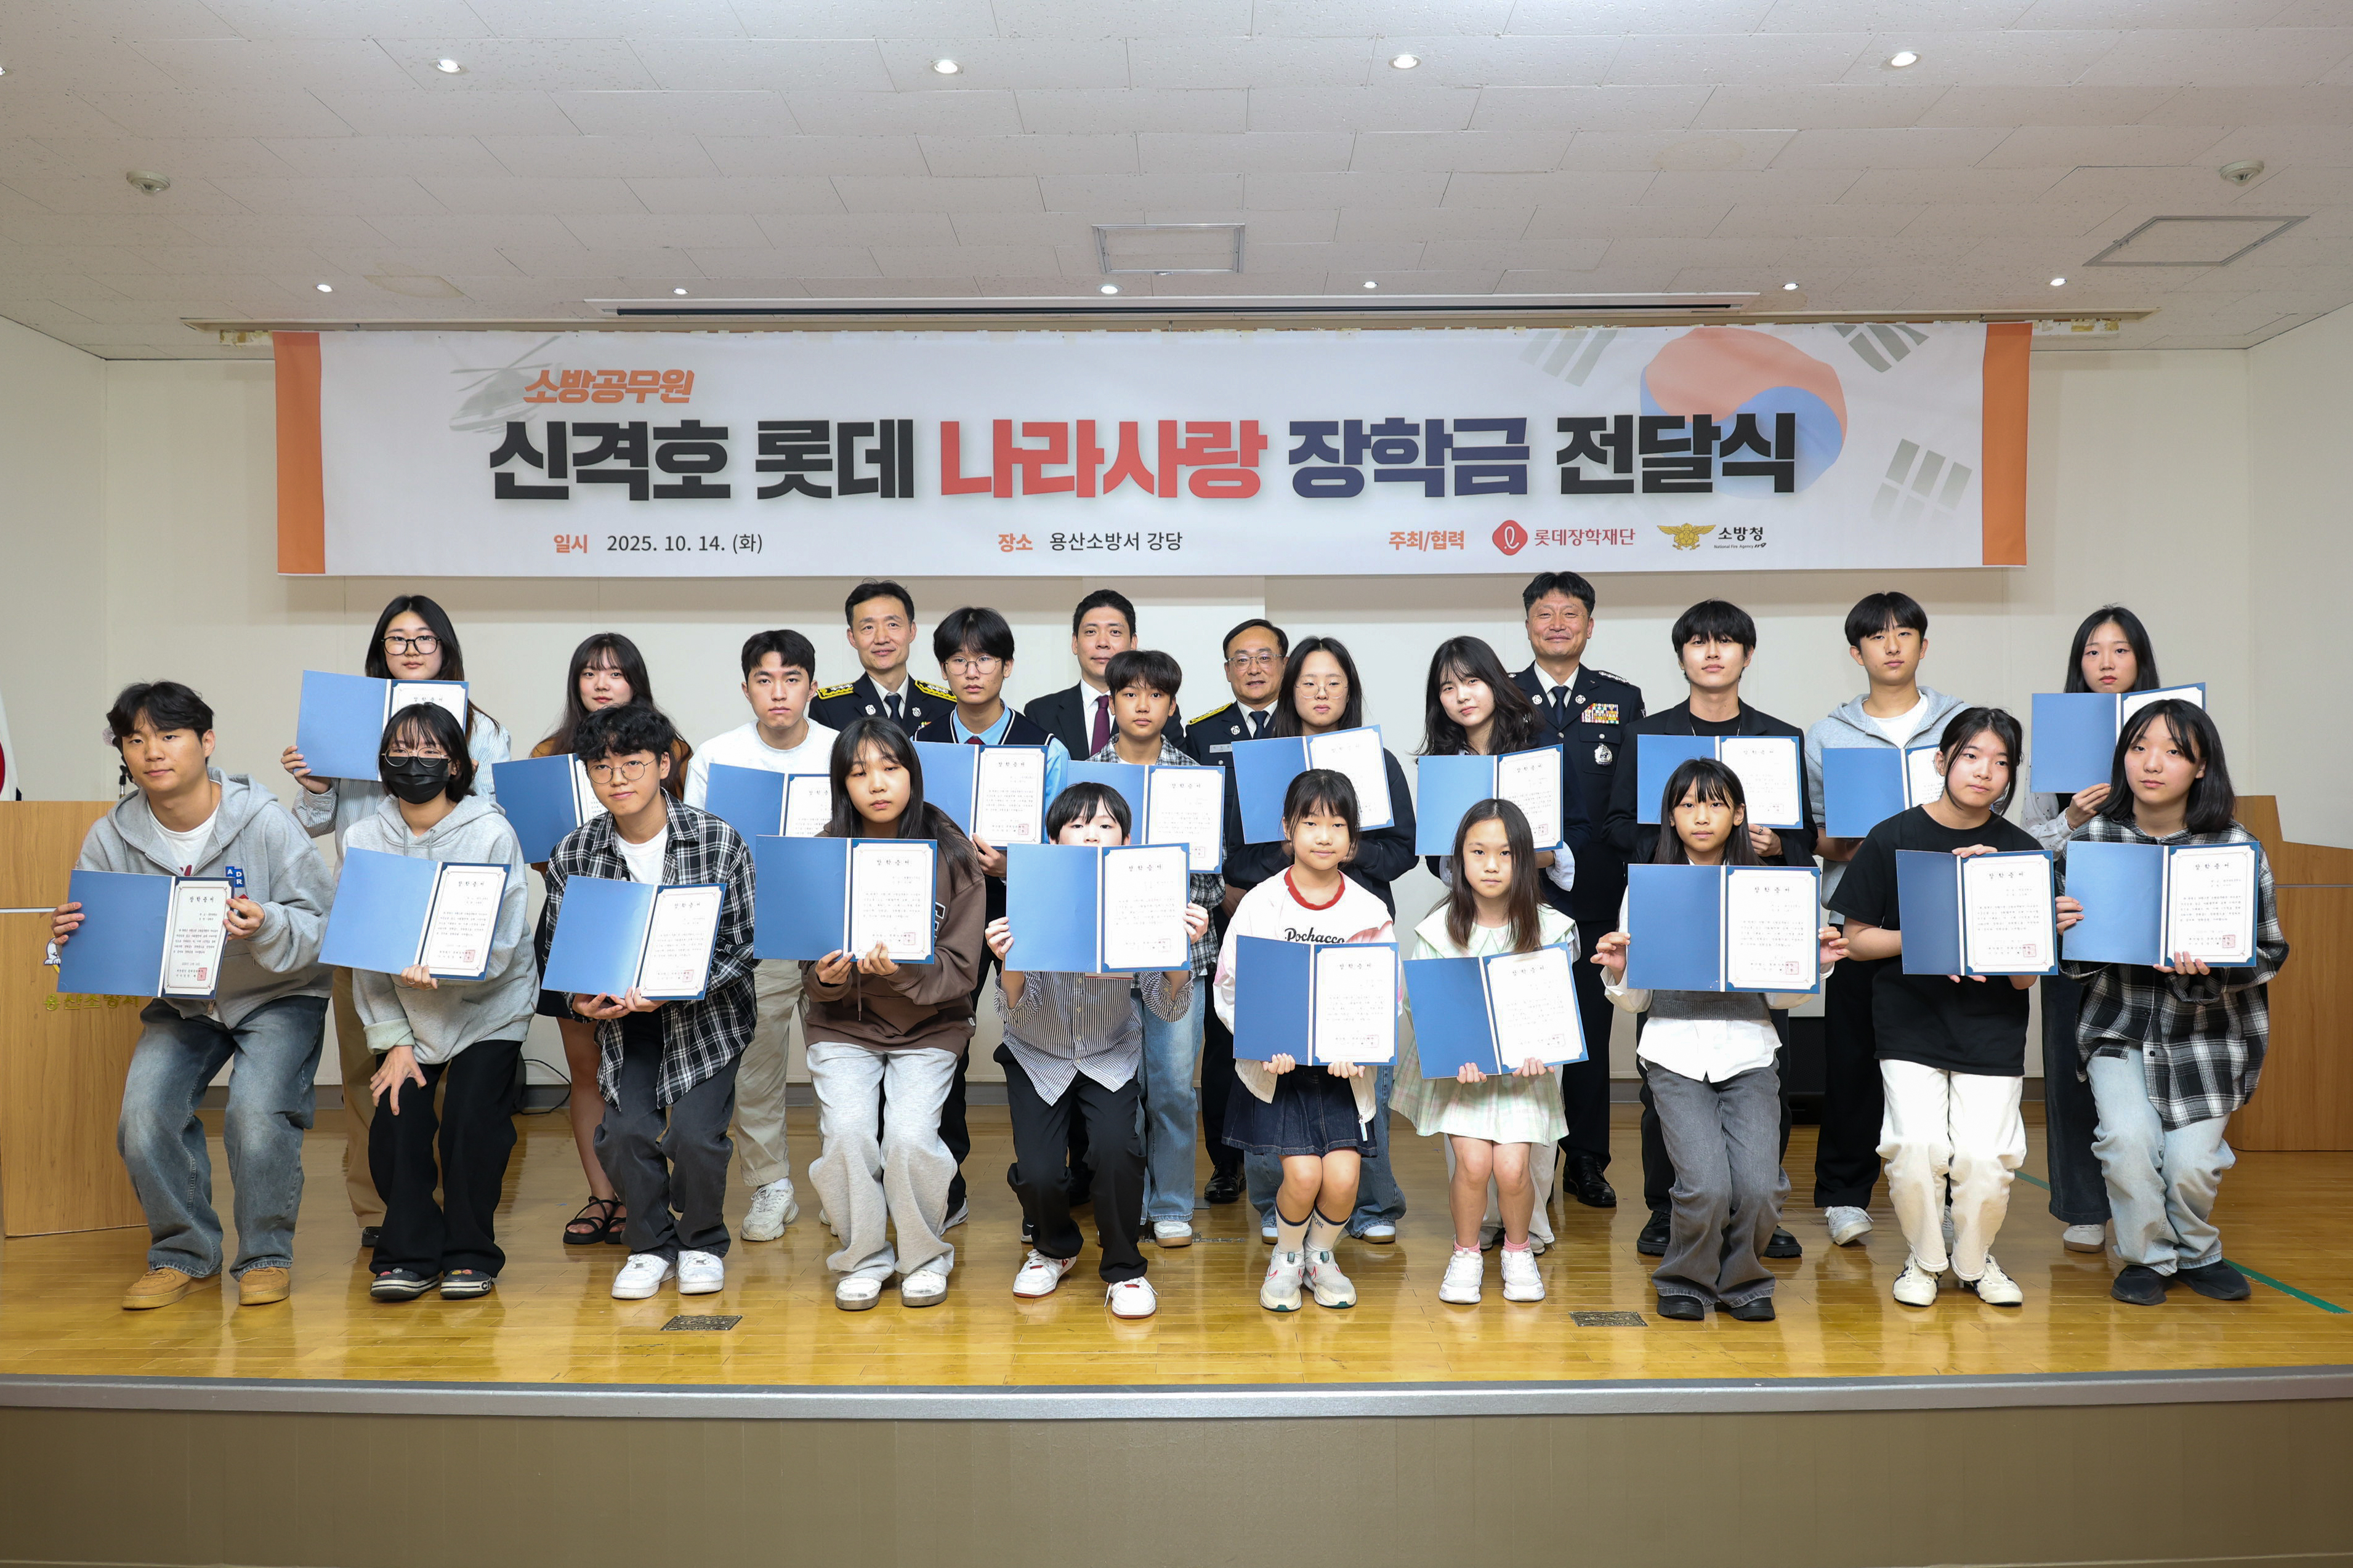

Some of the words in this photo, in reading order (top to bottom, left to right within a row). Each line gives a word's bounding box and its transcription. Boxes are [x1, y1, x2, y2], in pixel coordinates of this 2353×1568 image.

[523, 369, 695, 403] 소방공무원
[490, 419, 731, 501] 신격호
[756, 419, 914, 500] 롯데
[940, 419, 1268, 499] 나라사랑
[1288, 417, 1530, 498] 장학금
[1556, 412, 1796, 494] 전달식
[553, 534, 587, 554] 일시
[607, 535, 657, 552] 2025.
[664, 535, 691, 552] 10.
[698, 536, 725, 551] 14.
[733, 533, 762, 555] (화)
[998, 533, 1033, 553] 장소
[1049, 531, 1139, 552] 용산소방서
[1147, 531, 1183, 551] 강당
[1388, 529, 1464, 552] 주최/협력
[1534, 528, 1636, 547] 롯데장학재단
[1717, 526, 1763, 541] 소방청
[1285, 927, 1345, 943] Pochacco
